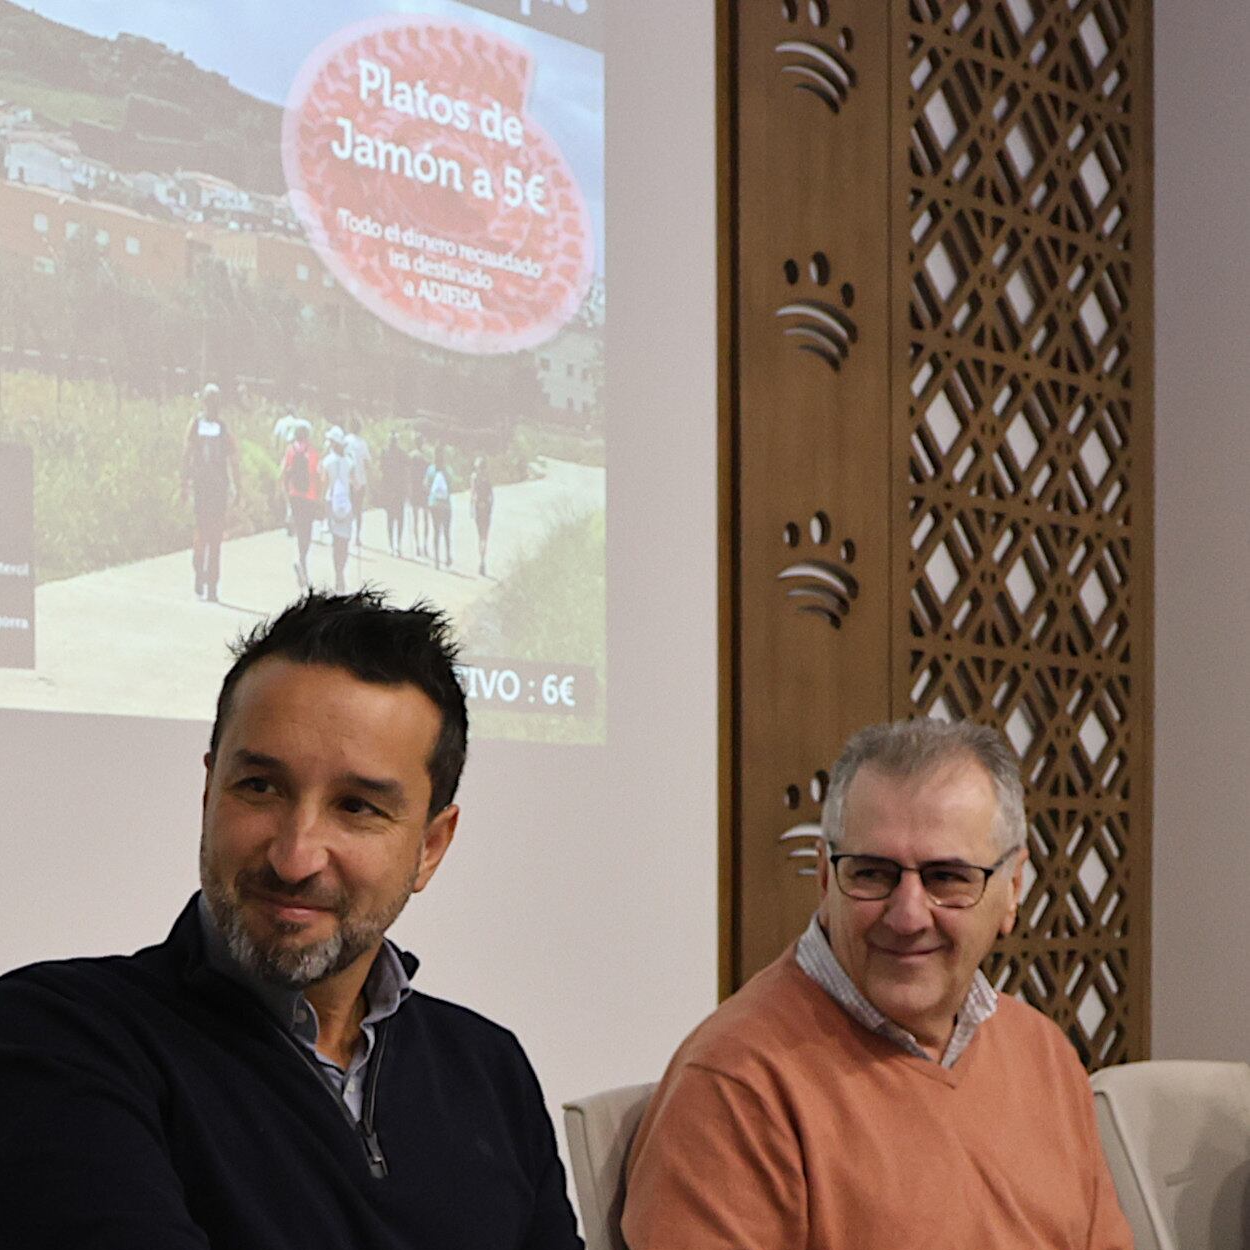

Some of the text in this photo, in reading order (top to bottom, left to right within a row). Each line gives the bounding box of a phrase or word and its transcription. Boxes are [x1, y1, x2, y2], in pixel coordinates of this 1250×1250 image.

[359, 58, 524, 147] Platos de
[331, 117, 548, 215] Jamón a 5€
[337, 208, 542, 280] Todo el dinero recaudado
[403, 280, 414, 297] a
[413, 253, 493, 291] destinado
[542, 674, 576, 706] 6€
